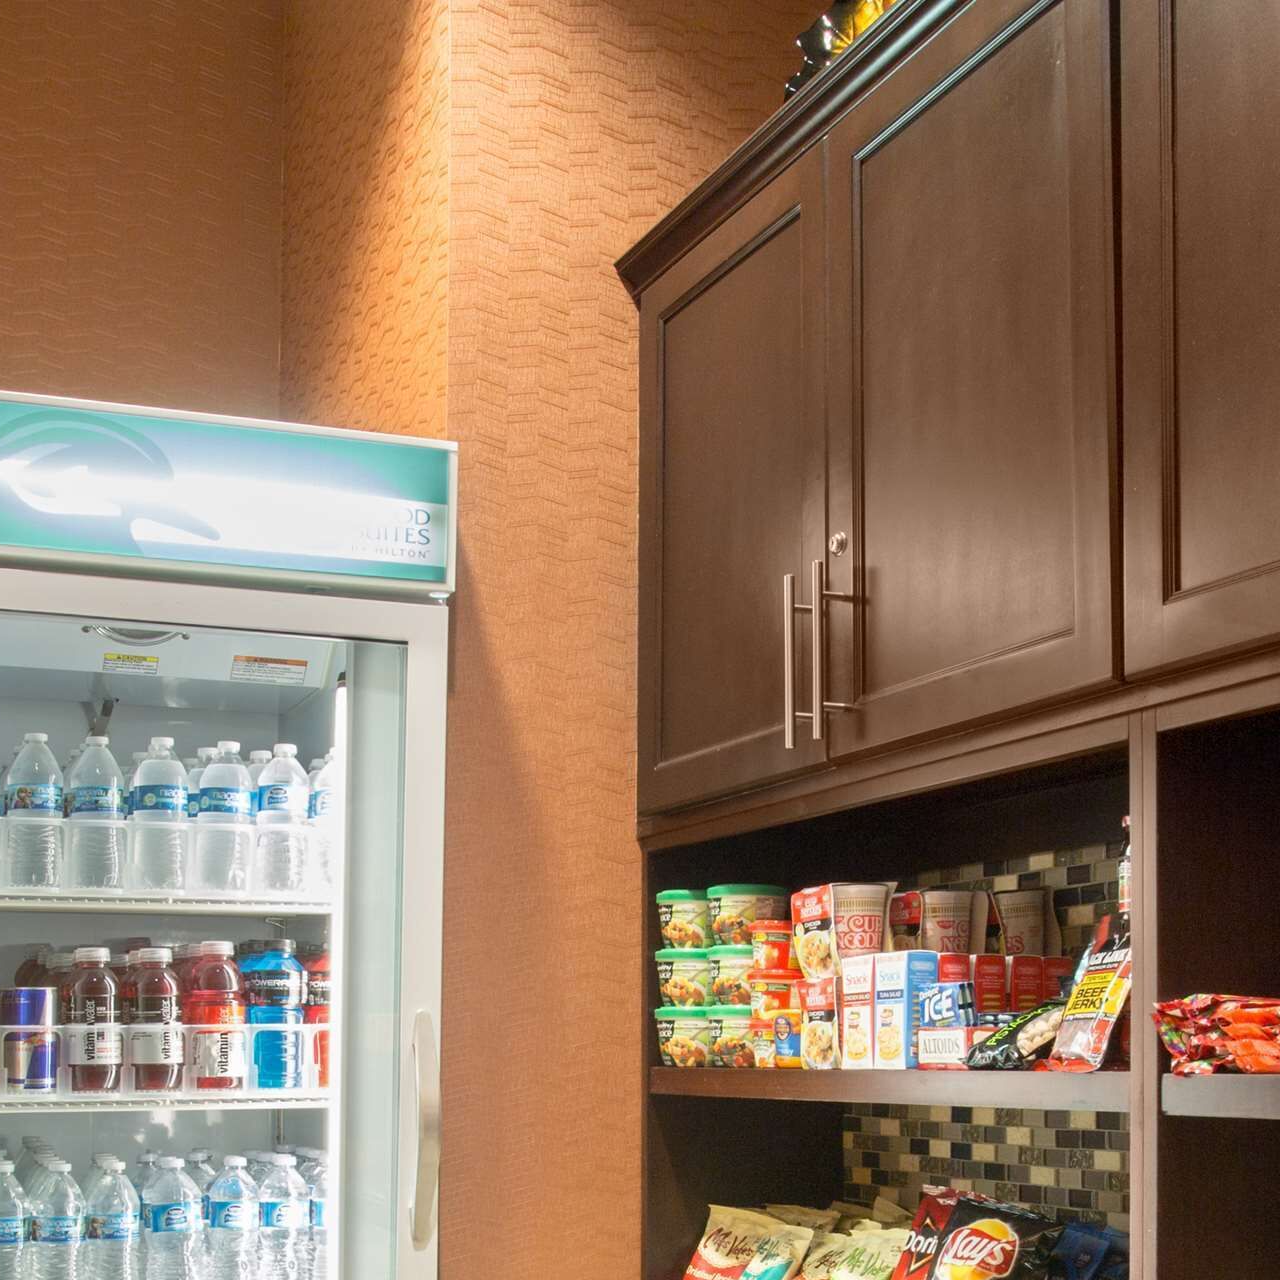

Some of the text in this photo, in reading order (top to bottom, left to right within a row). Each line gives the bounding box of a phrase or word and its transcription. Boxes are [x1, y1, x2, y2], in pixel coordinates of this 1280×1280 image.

[846, 974, 868, 986] Snack
[879, 971, 902, 983] Snack
[1075, 986, 1107, 1000] BEEF
[925, 989, 955, 1024] ICE
[1069, 997, 1110, 1011] JERKY
[923, 1037, 961, 1055] ALTOIDS
[945, 1229, 1013, 1268] Lay's
